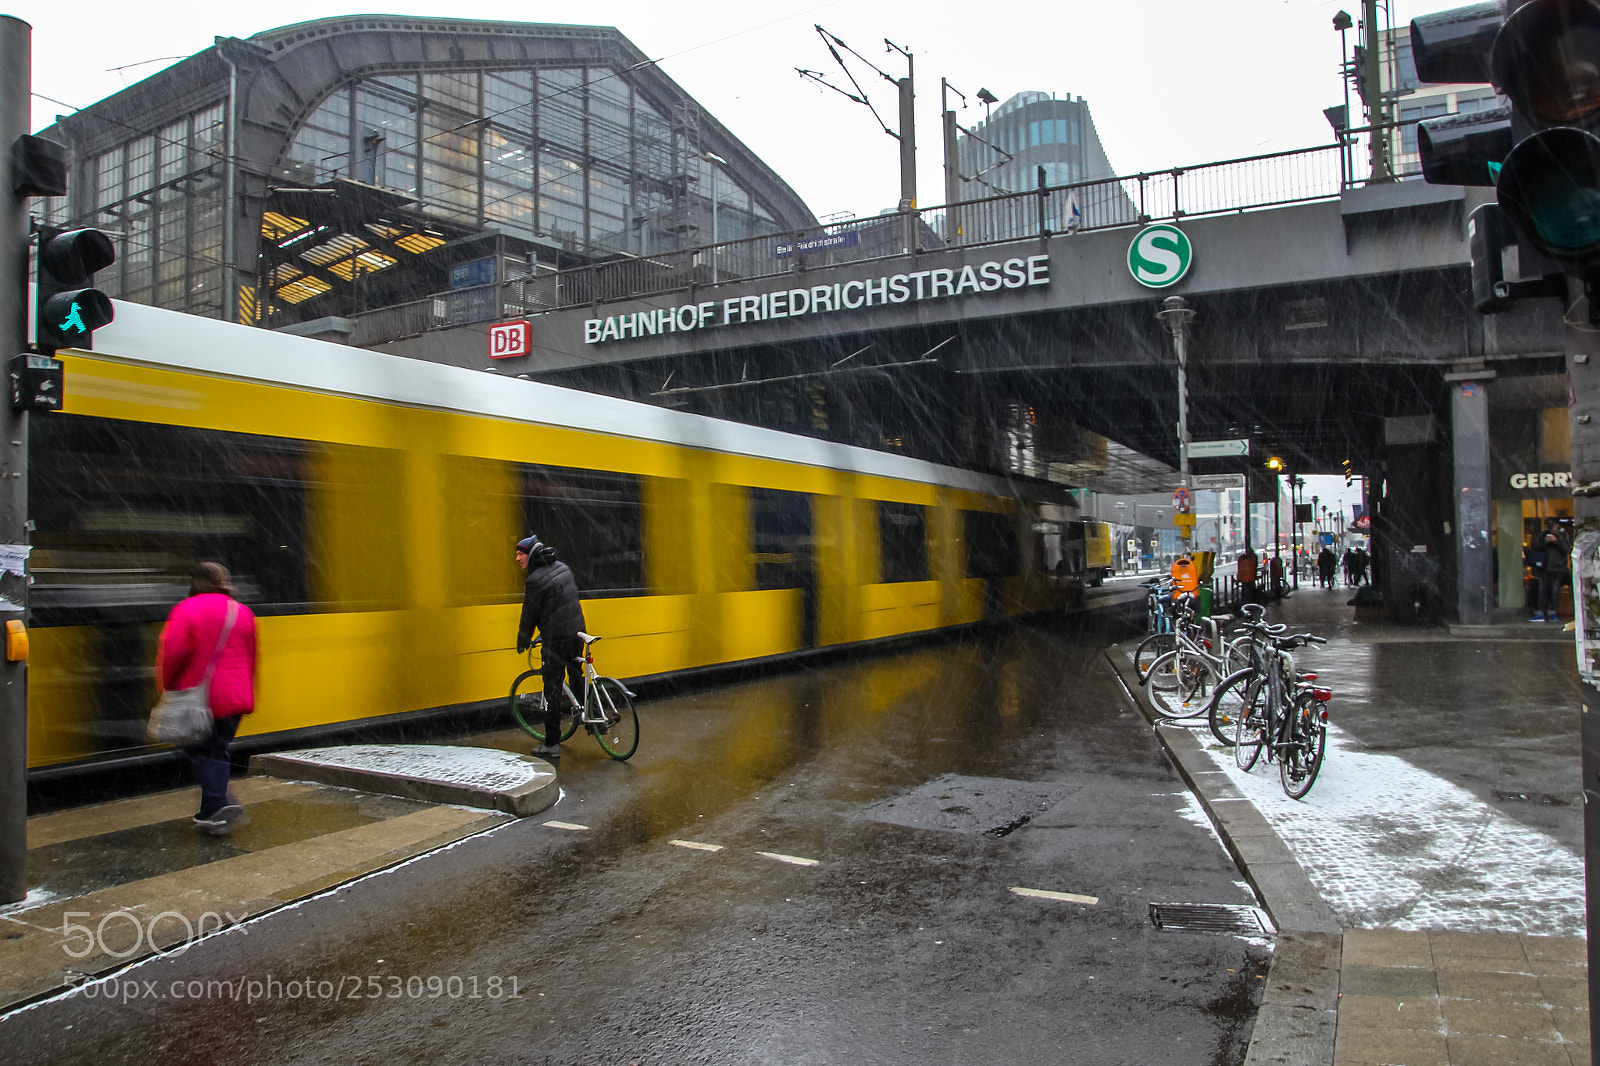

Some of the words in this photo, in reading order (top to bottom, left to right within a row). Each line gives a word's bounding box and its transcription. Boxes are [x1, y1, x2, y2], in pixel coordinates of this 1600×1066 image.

[1137, 229, 1182, 283] S
[584, 301, 716, 344] BAHNHOF
[723, 254, 1050, 325] FRIEDRICHSTRASSE
[494, 328, 521, 354] DB
